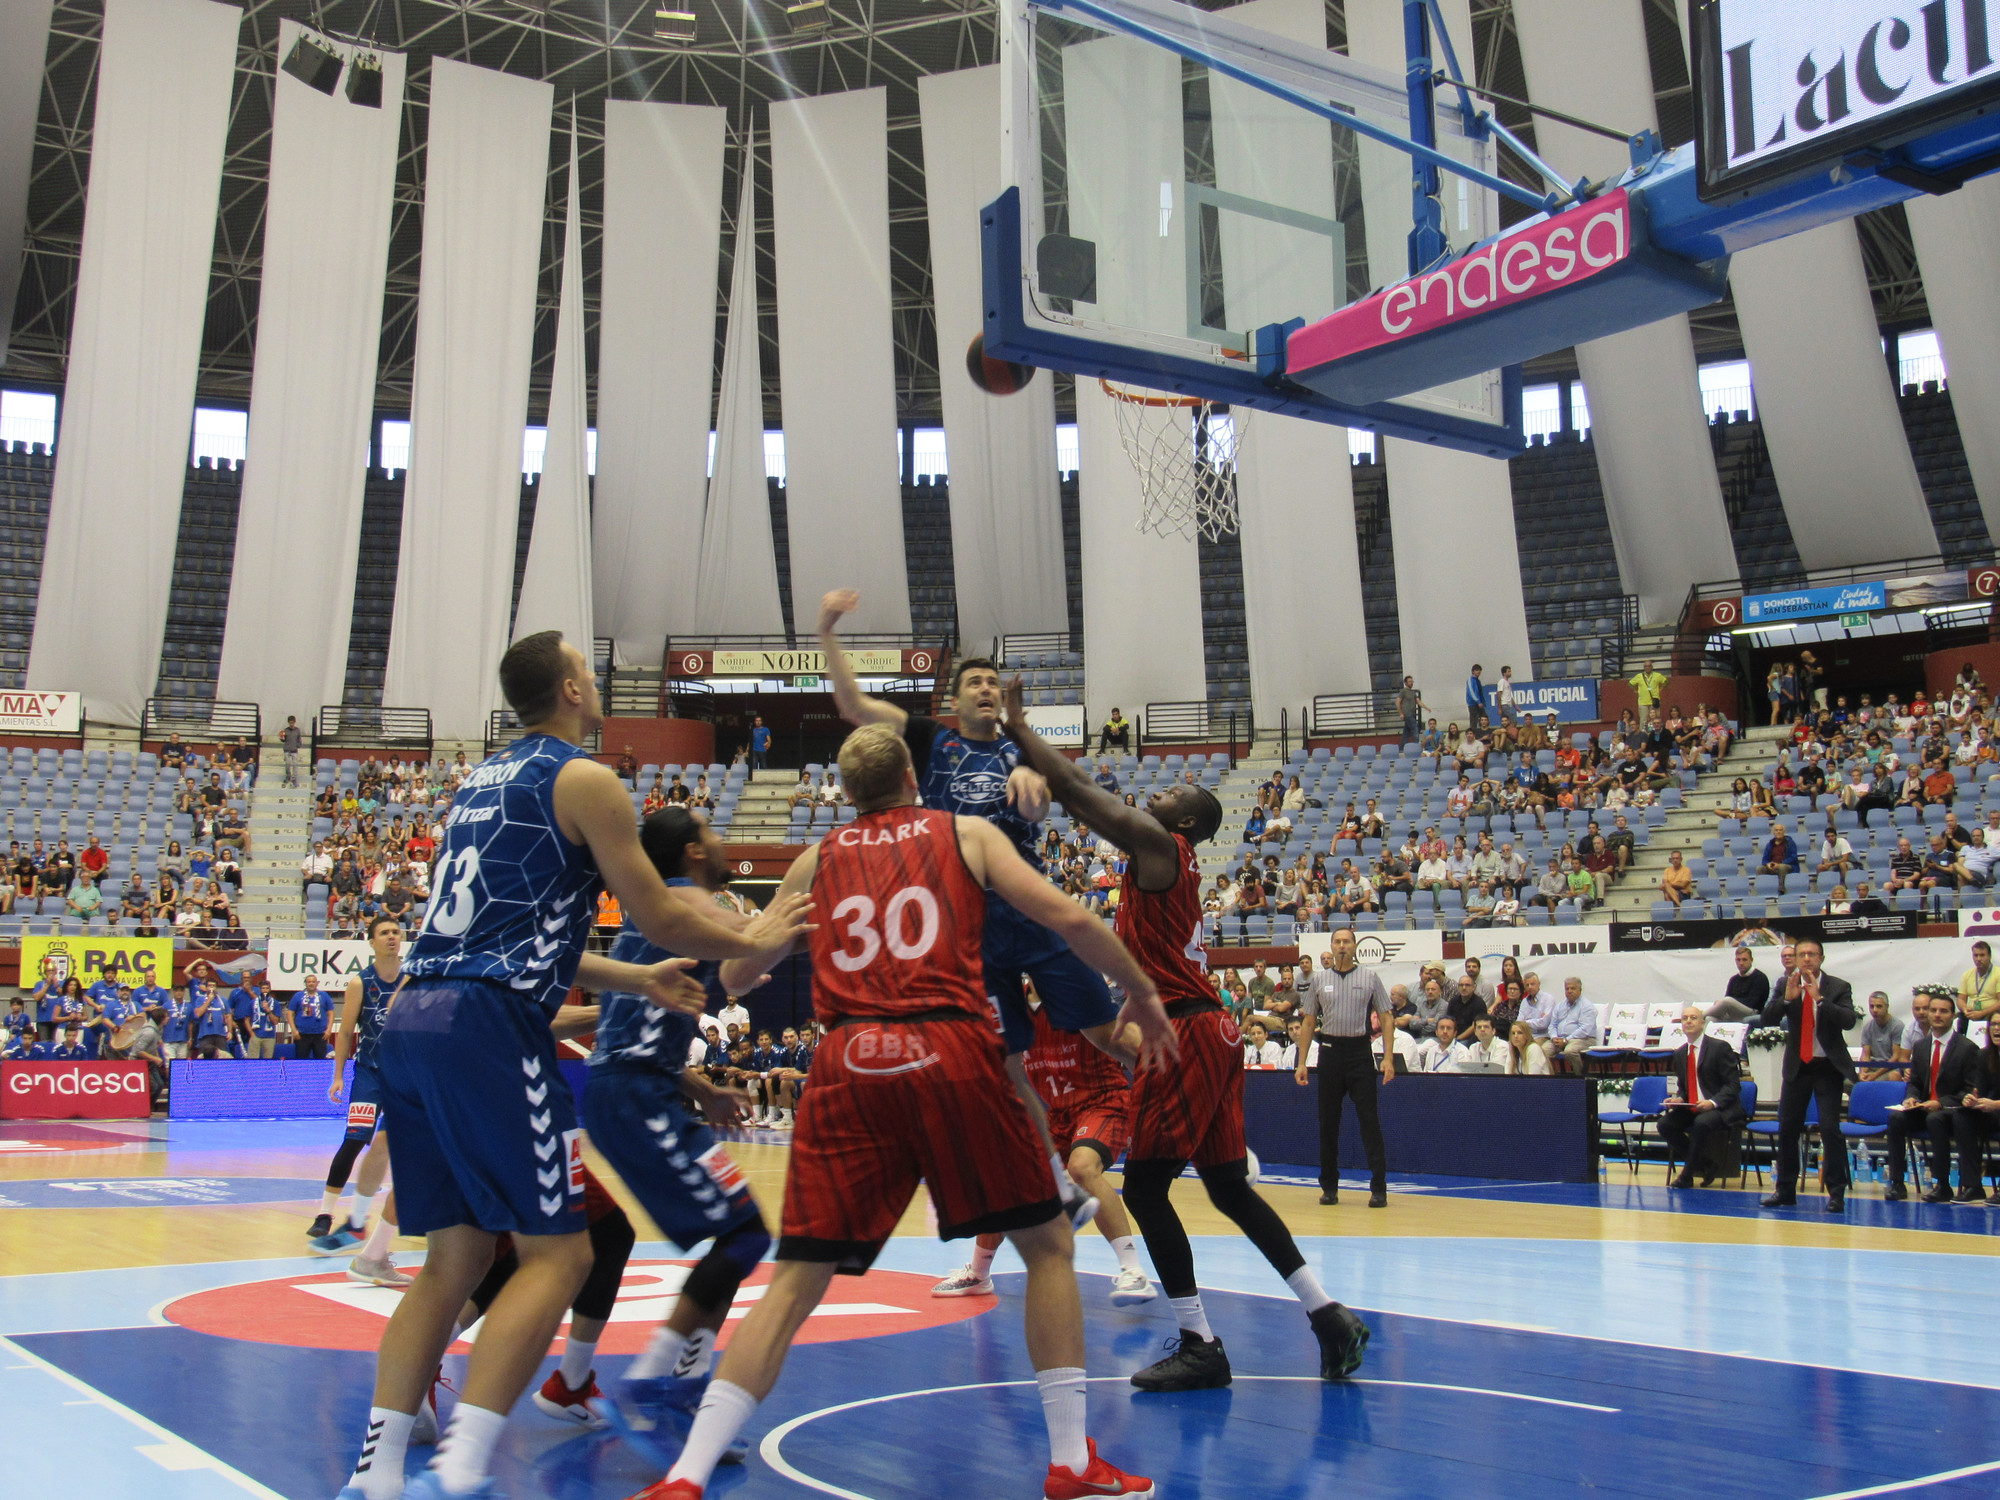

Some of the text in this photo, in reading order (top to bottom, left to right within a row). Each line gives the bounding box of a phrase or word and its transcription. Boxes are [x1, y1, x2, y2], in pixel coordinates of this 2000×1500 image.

[1381, 208, 1623, 334] endesa
[1983, 577, 1993, 590] 7
[1763, 597, 1809, 608] DONOSTIA
[1719, 606, 1728, 619] 7
[1763, 607, 1780, 615] SAN
[688, 658, 697, 669] 6
[917, 656, 925, 668] 6
[1488, 686, 1588, 707] TNDA OFICIAL
[0, 717, 41, 727] MIENTAS
[838, 818, 931, 847] CLARK
[420, 846, 480, 936] 13
[831, 886, 939, 972] 30
[1358, 948, 1382, 958] MINI
[84, 949, 157, 974] RAC
[10, 1067, 145, 1095] endesa
